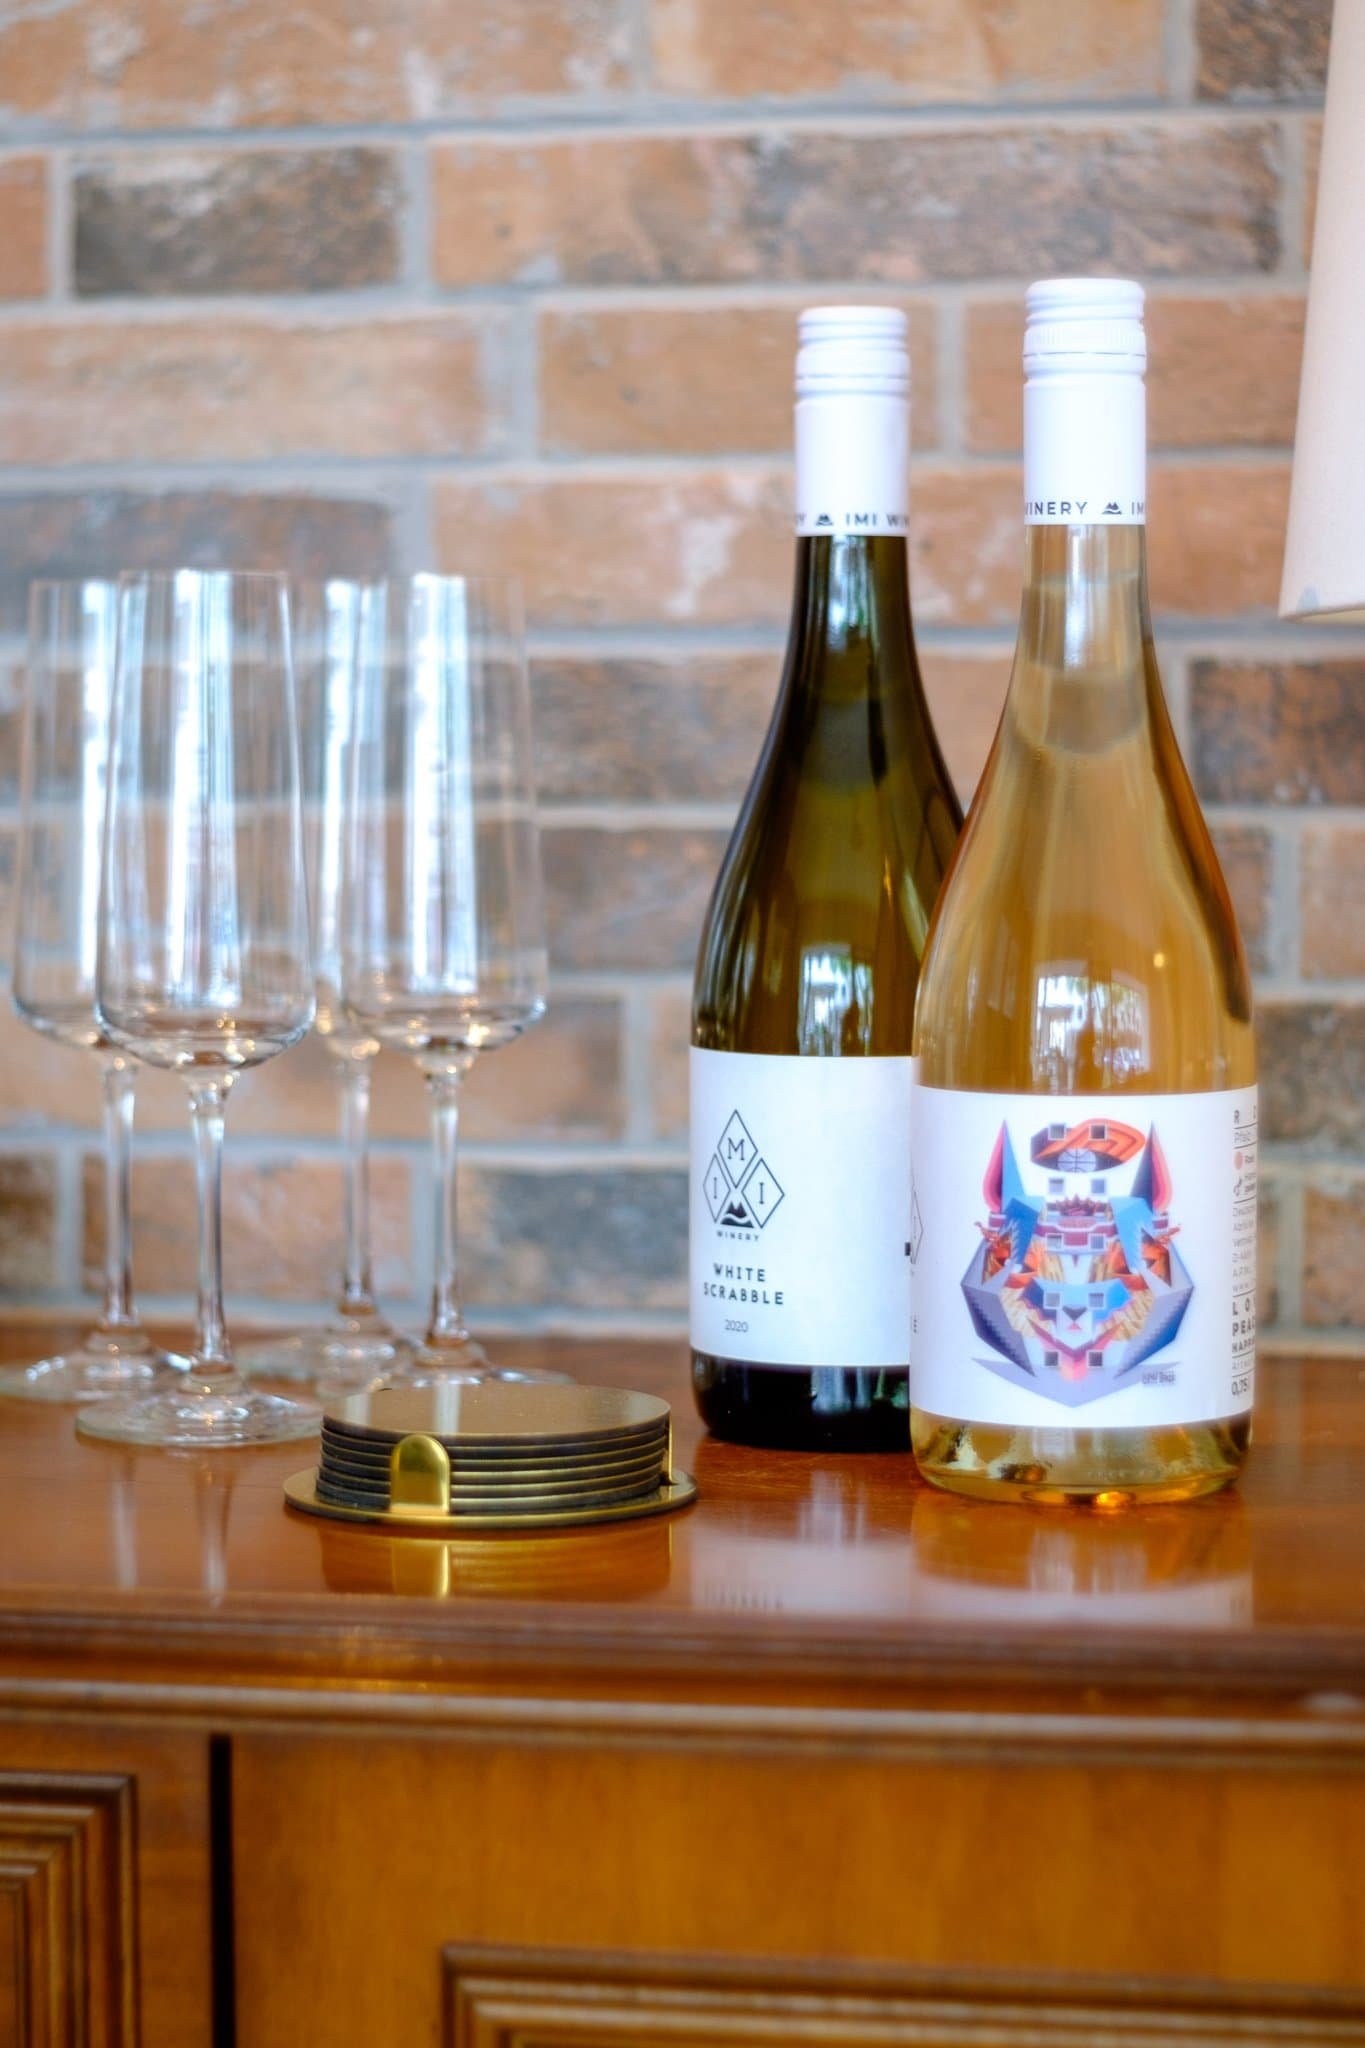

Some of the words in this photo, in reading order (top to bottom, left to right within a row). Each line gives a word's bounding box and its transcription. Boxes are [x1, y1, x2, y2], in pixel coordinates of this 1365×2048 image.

[845, 512, 877, 527] IMI
[713, 1261, 766, 1282] WHITE
[703, 1281, 784, 1305] SCRABBLE
[724, 1318, 750, 1334] 2020
